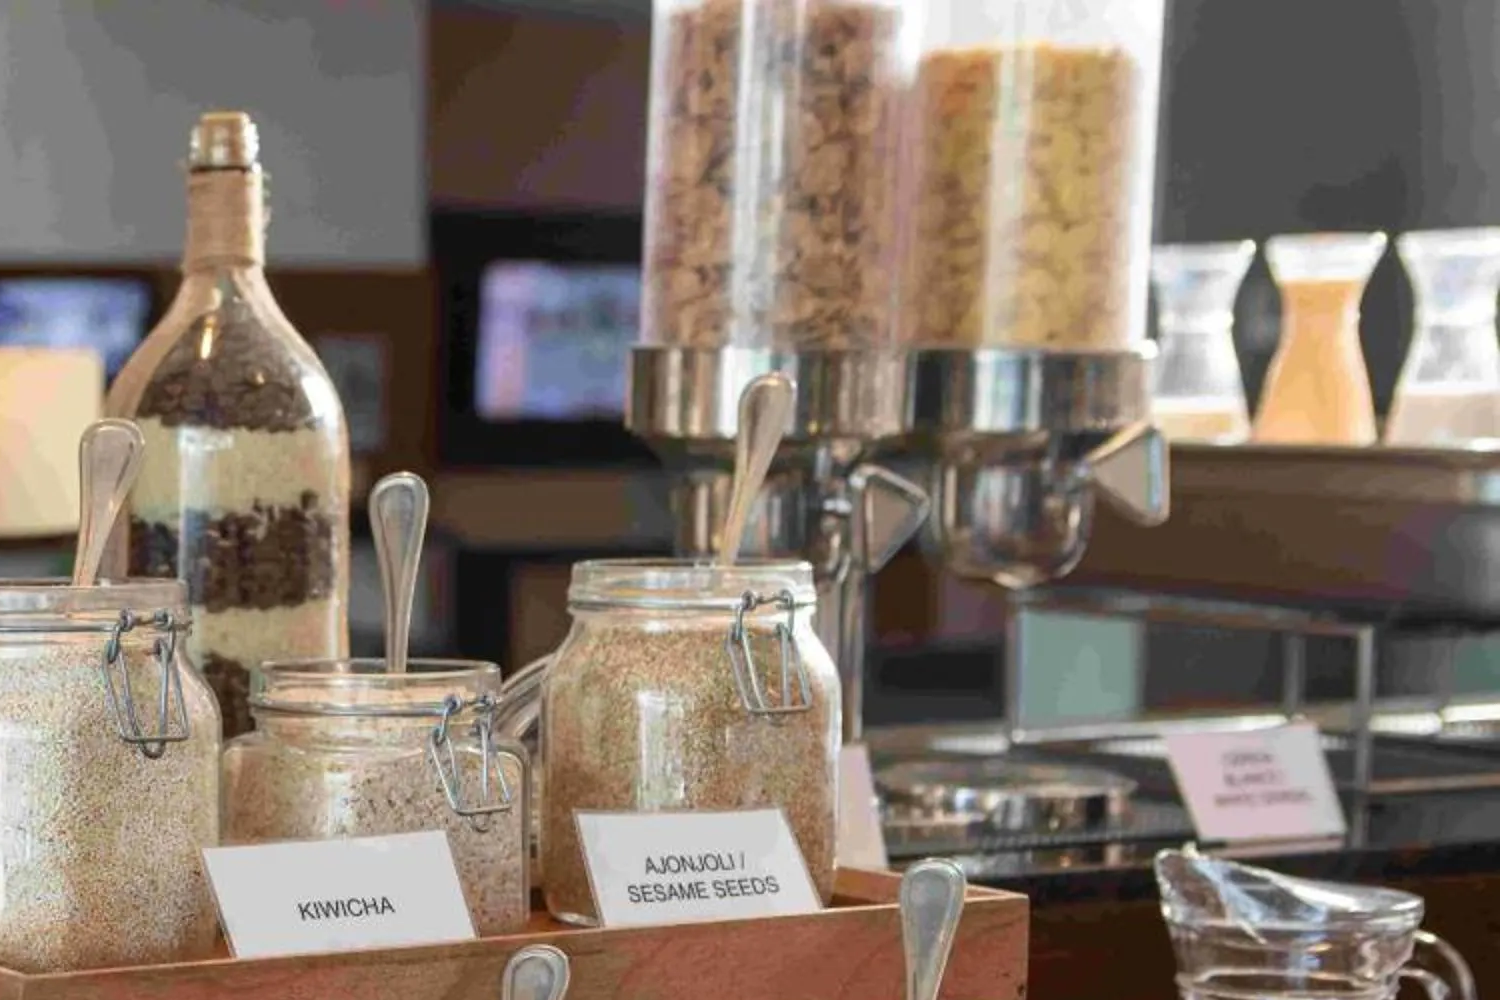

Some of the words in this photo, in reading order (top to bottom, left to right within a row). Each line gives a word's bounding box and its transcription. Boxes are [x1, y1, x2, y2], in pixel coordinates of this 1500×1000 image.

[645, 852, 735, 875] AJONJOLI
[627, 881, 710, 903] SESAME
[712, 875, 781, 899] SEEDS
[298, 896, 395, 921] KIWICHA
